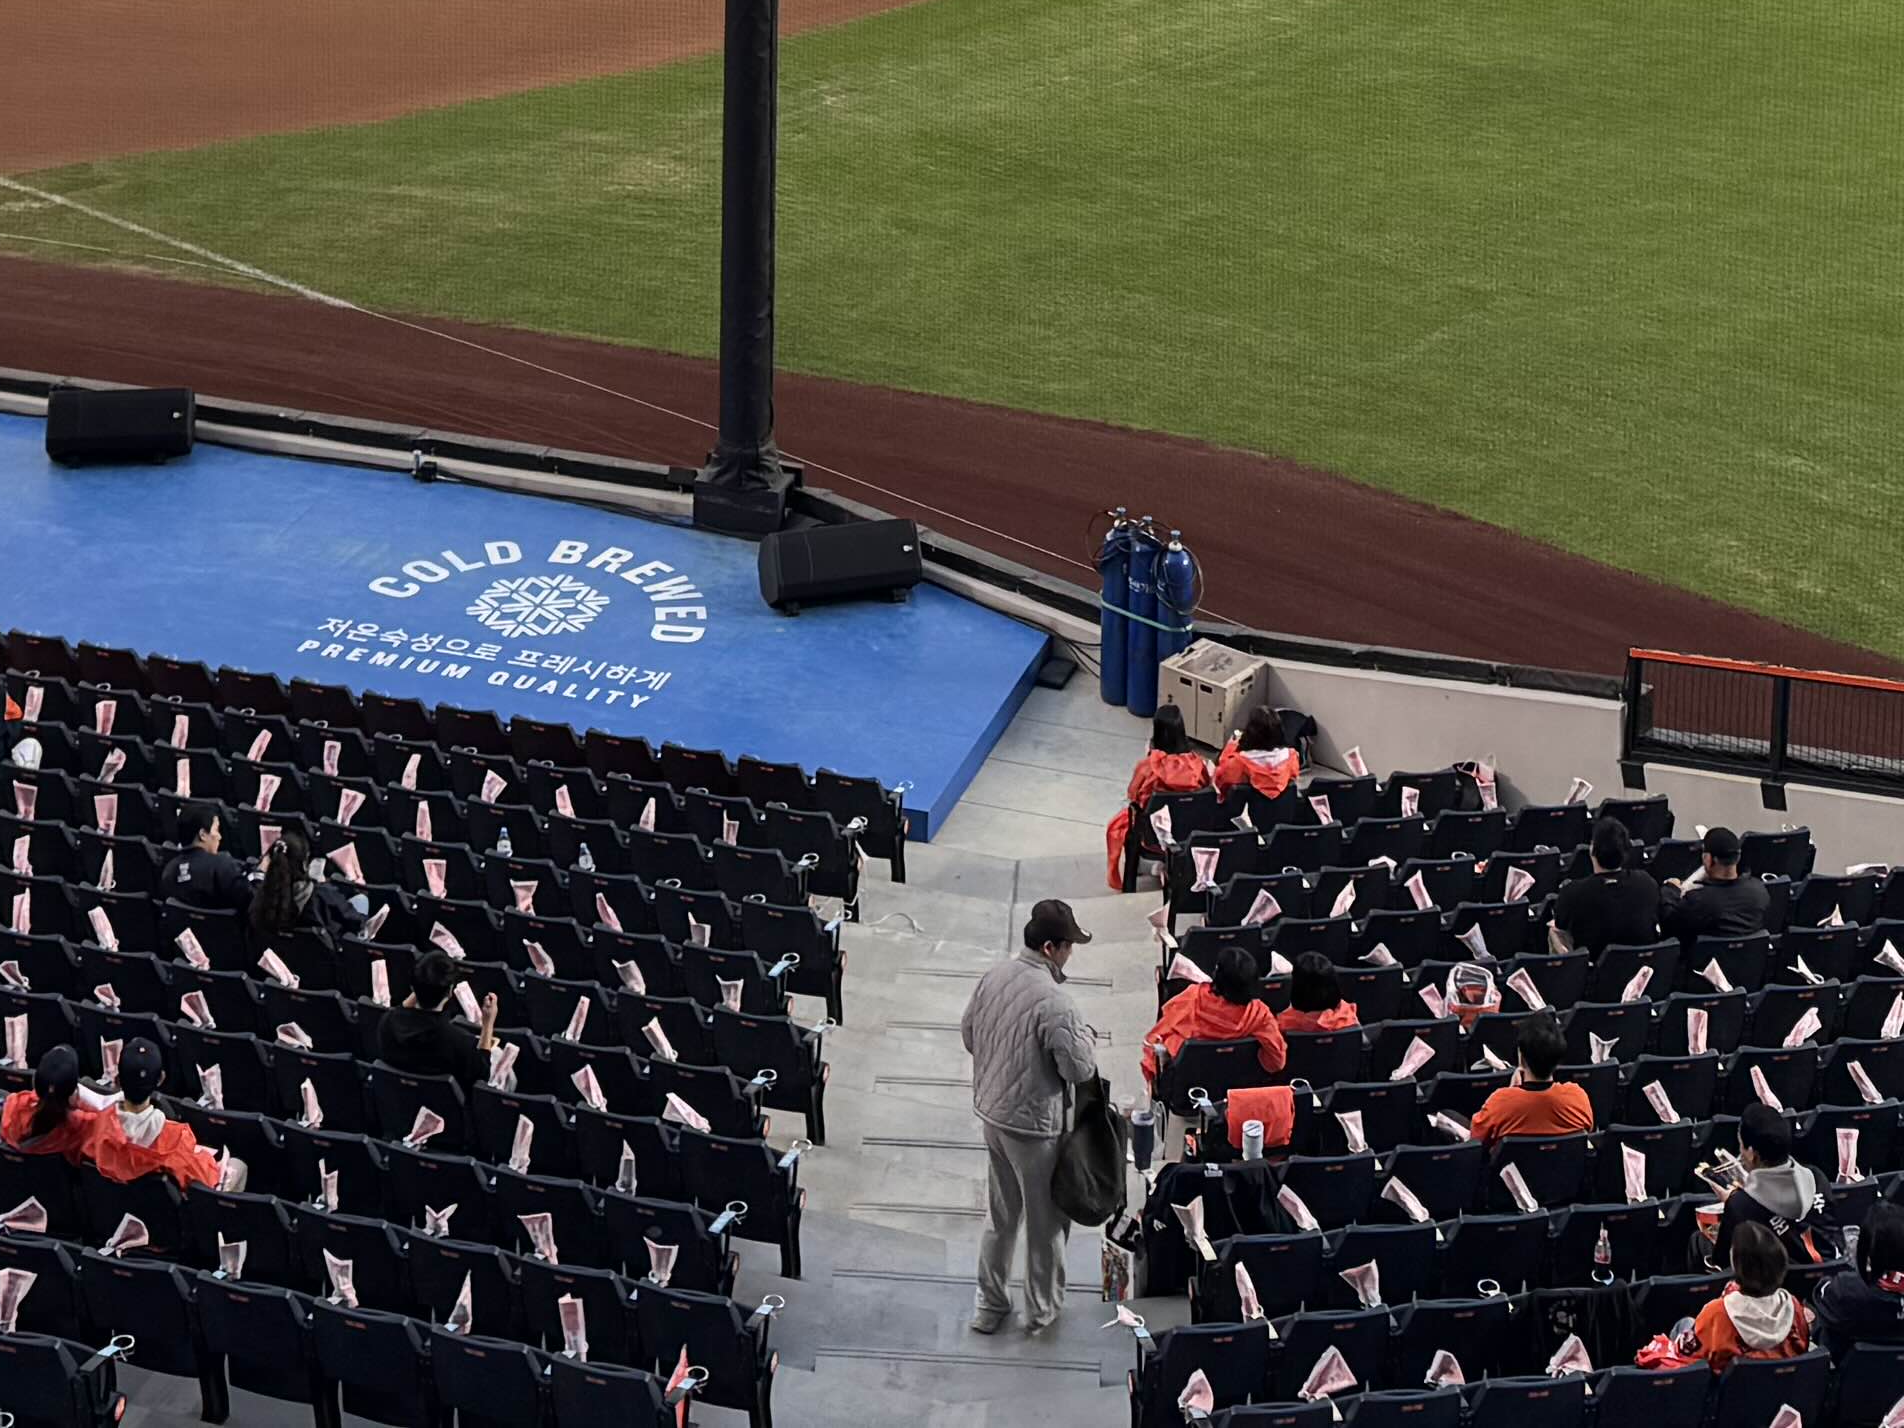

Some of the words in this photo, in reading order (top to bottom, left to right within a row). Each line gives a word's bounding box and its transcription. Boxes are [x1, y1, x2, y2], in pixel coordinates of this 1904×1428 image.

[368, 540, 523, 599] COLD
[547, 540, 707, 644] BREWED
[296, 639, 471, 680] PREMIUM
[487, 670, 654, 710] QUALITY
[318, 616, 503, 662] 저온숙성으로
[507, 649, 672, 692] 프레시하게
